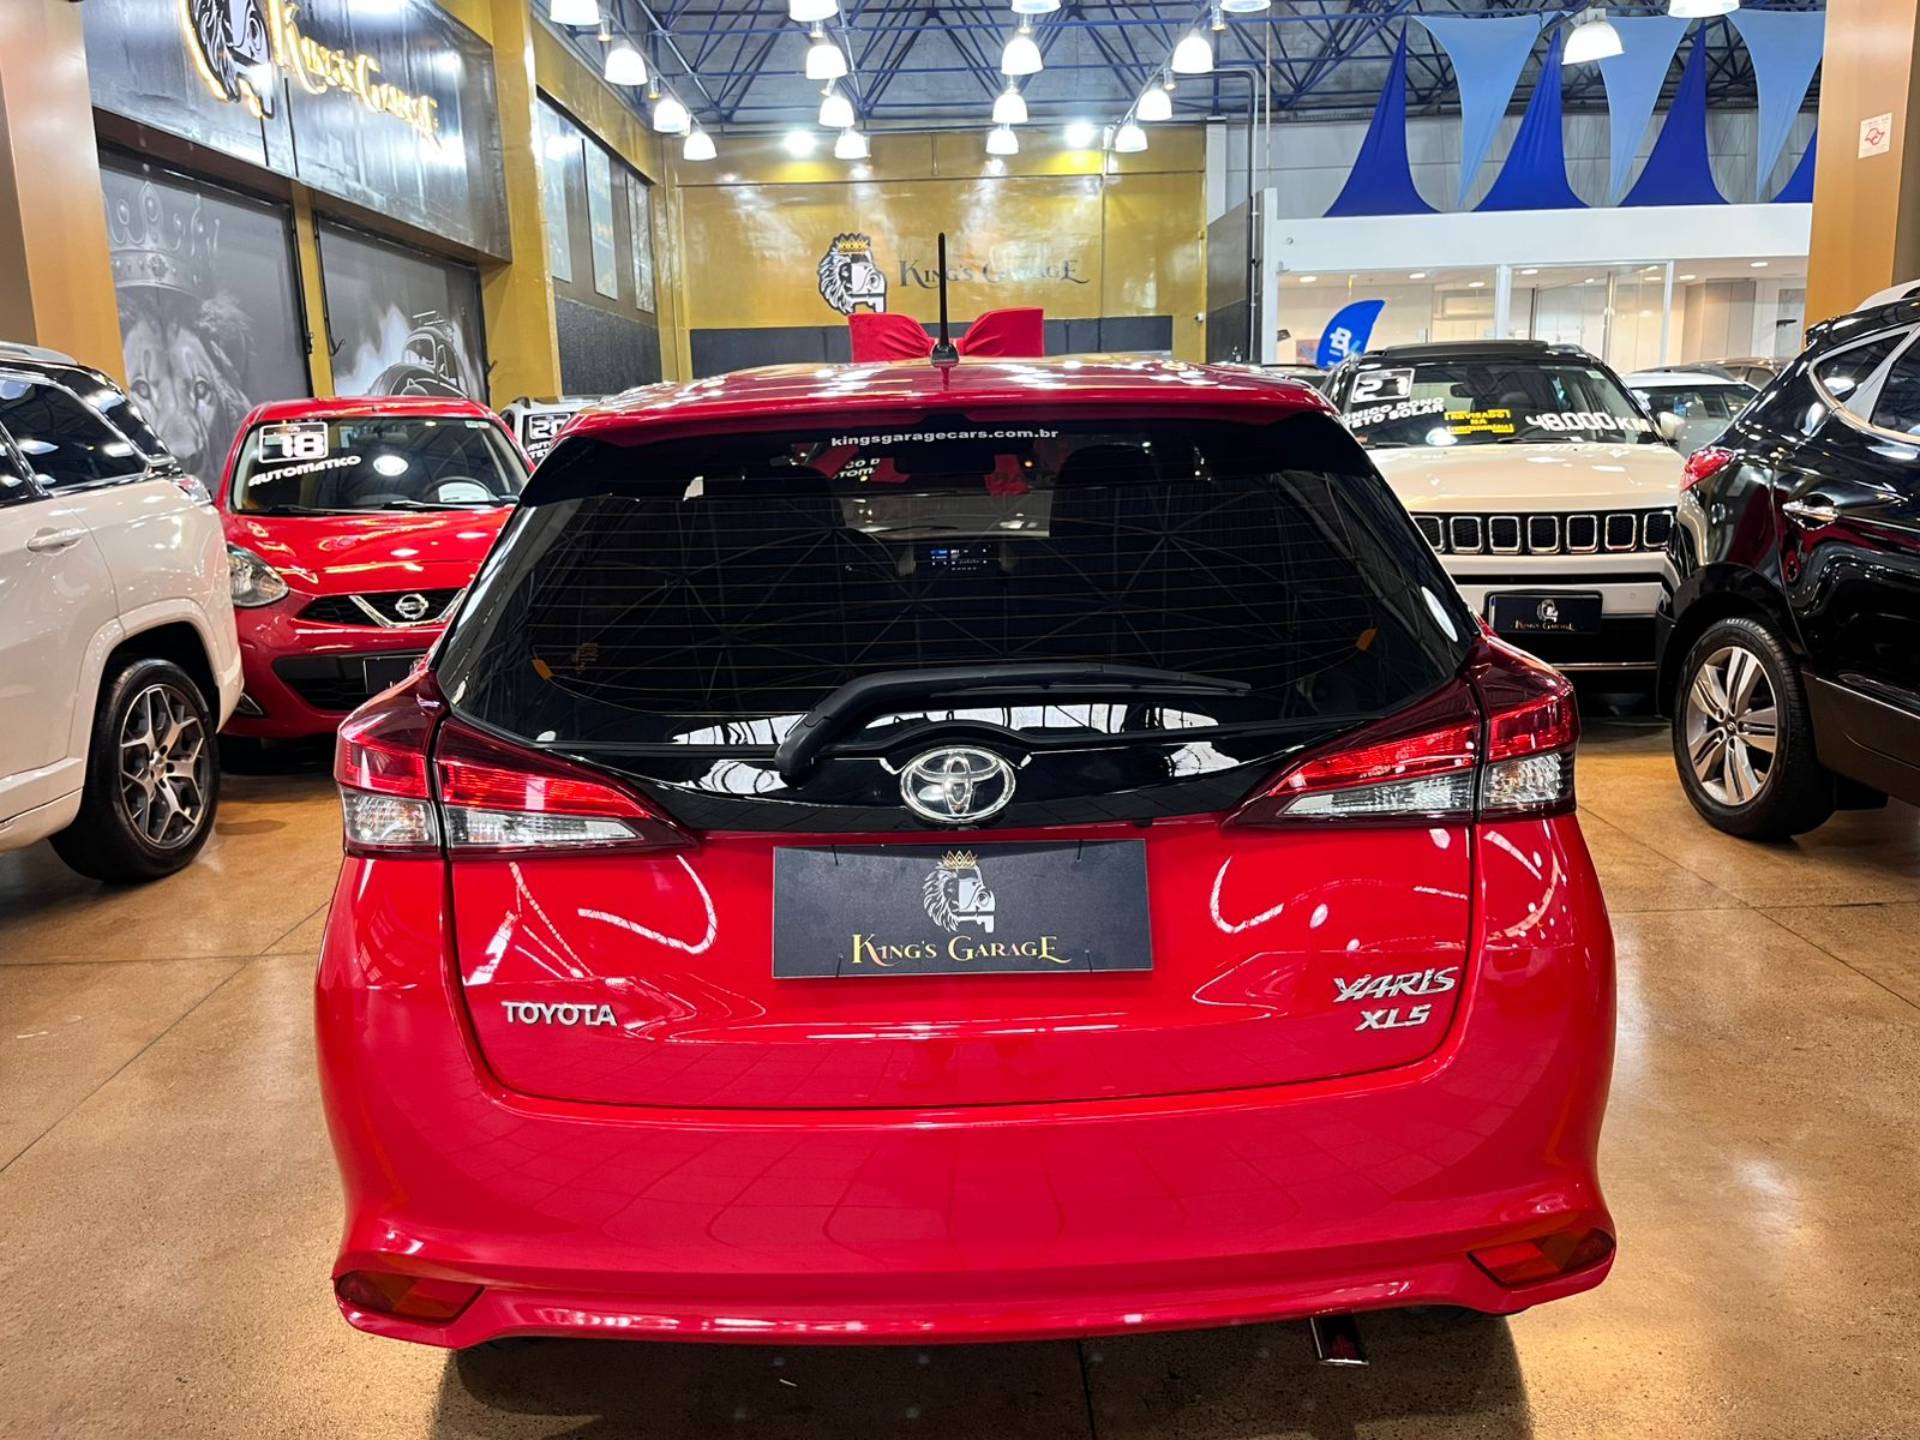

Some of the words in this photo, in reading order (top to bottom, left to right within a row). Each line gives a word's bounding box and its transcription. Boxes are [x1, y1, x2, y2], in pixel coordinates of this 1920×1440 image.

[1356, 376, 1410, 400] 21
[1388, 404, 1444, 420] SOLAR
[1396, 397, 1444, 411] DONO
[1525, 412, 1617, 431] 48.000
[1615, 417, 1651, 432] KM
[280, 434, 325, 457] 18
[831, 428, 1059, 447] kingsgaragecars.com.br
[852, 933, 937, 967] KING'S
[948, 935, 1073, 964] GARAGE
[1333, 966, 1459, 1002] YARIS
[501, 1001, 618, 1027] TOYOTA
[1355, 1003, 1432, 1031] XLS
